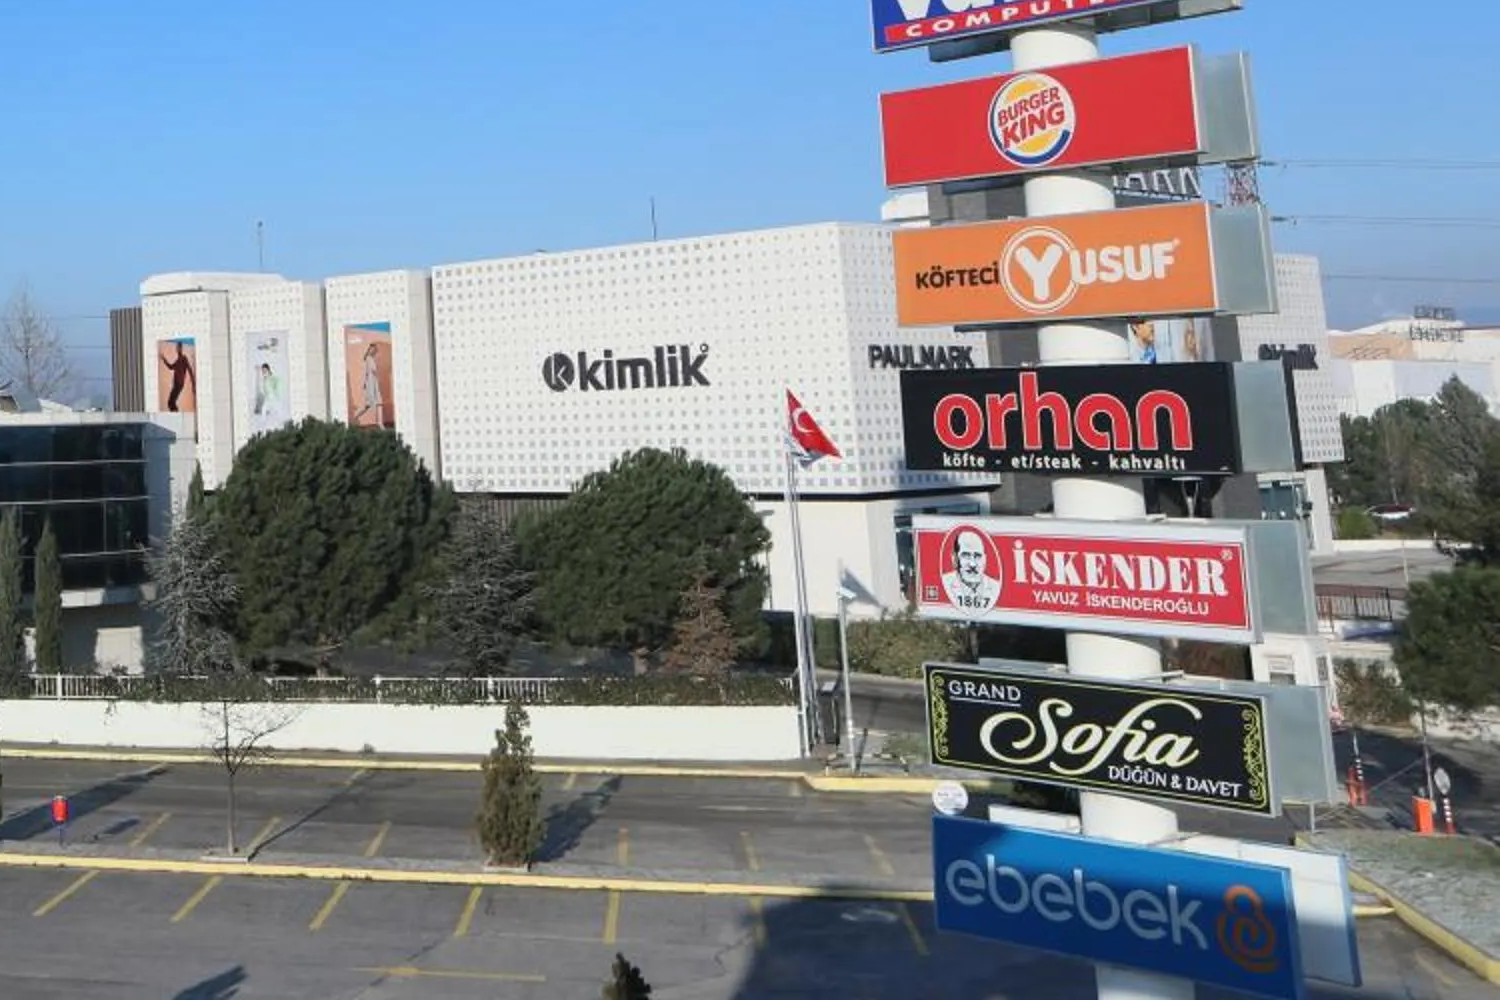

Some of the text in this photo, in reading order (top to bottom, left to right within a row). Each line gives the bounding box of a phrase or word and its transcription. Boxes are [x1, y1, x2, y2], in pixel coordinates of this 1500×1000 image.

[998, 86, 1061, 127] BURGER
[1001, 101, 1066, 150] KING
[915, 240, 1176, 301] KÖFTECİ YUSUF
[577, 344, 711, 391] kimlik
[934, 372, 1193, 452] orhan
[943, 453, 986, 468] köfte
[1011, 453, 1082, 470] et/steak
[1108, 454, 1185, 471] kahvaltı
[1011, 539, 1229, 597] İSKENDER
[957, 594, 991, 610] 1867
[1032, 589, 1209, 616] YAVUZ İSKENDEROĞLU
[948, 680, 1021, 701] GRAND
[979, 698, 1203, 776] Sofia
[1107, 764, 1243, 798] DÜĞÜN & DAVET
[945, 853, 1209, 951] ebebek
